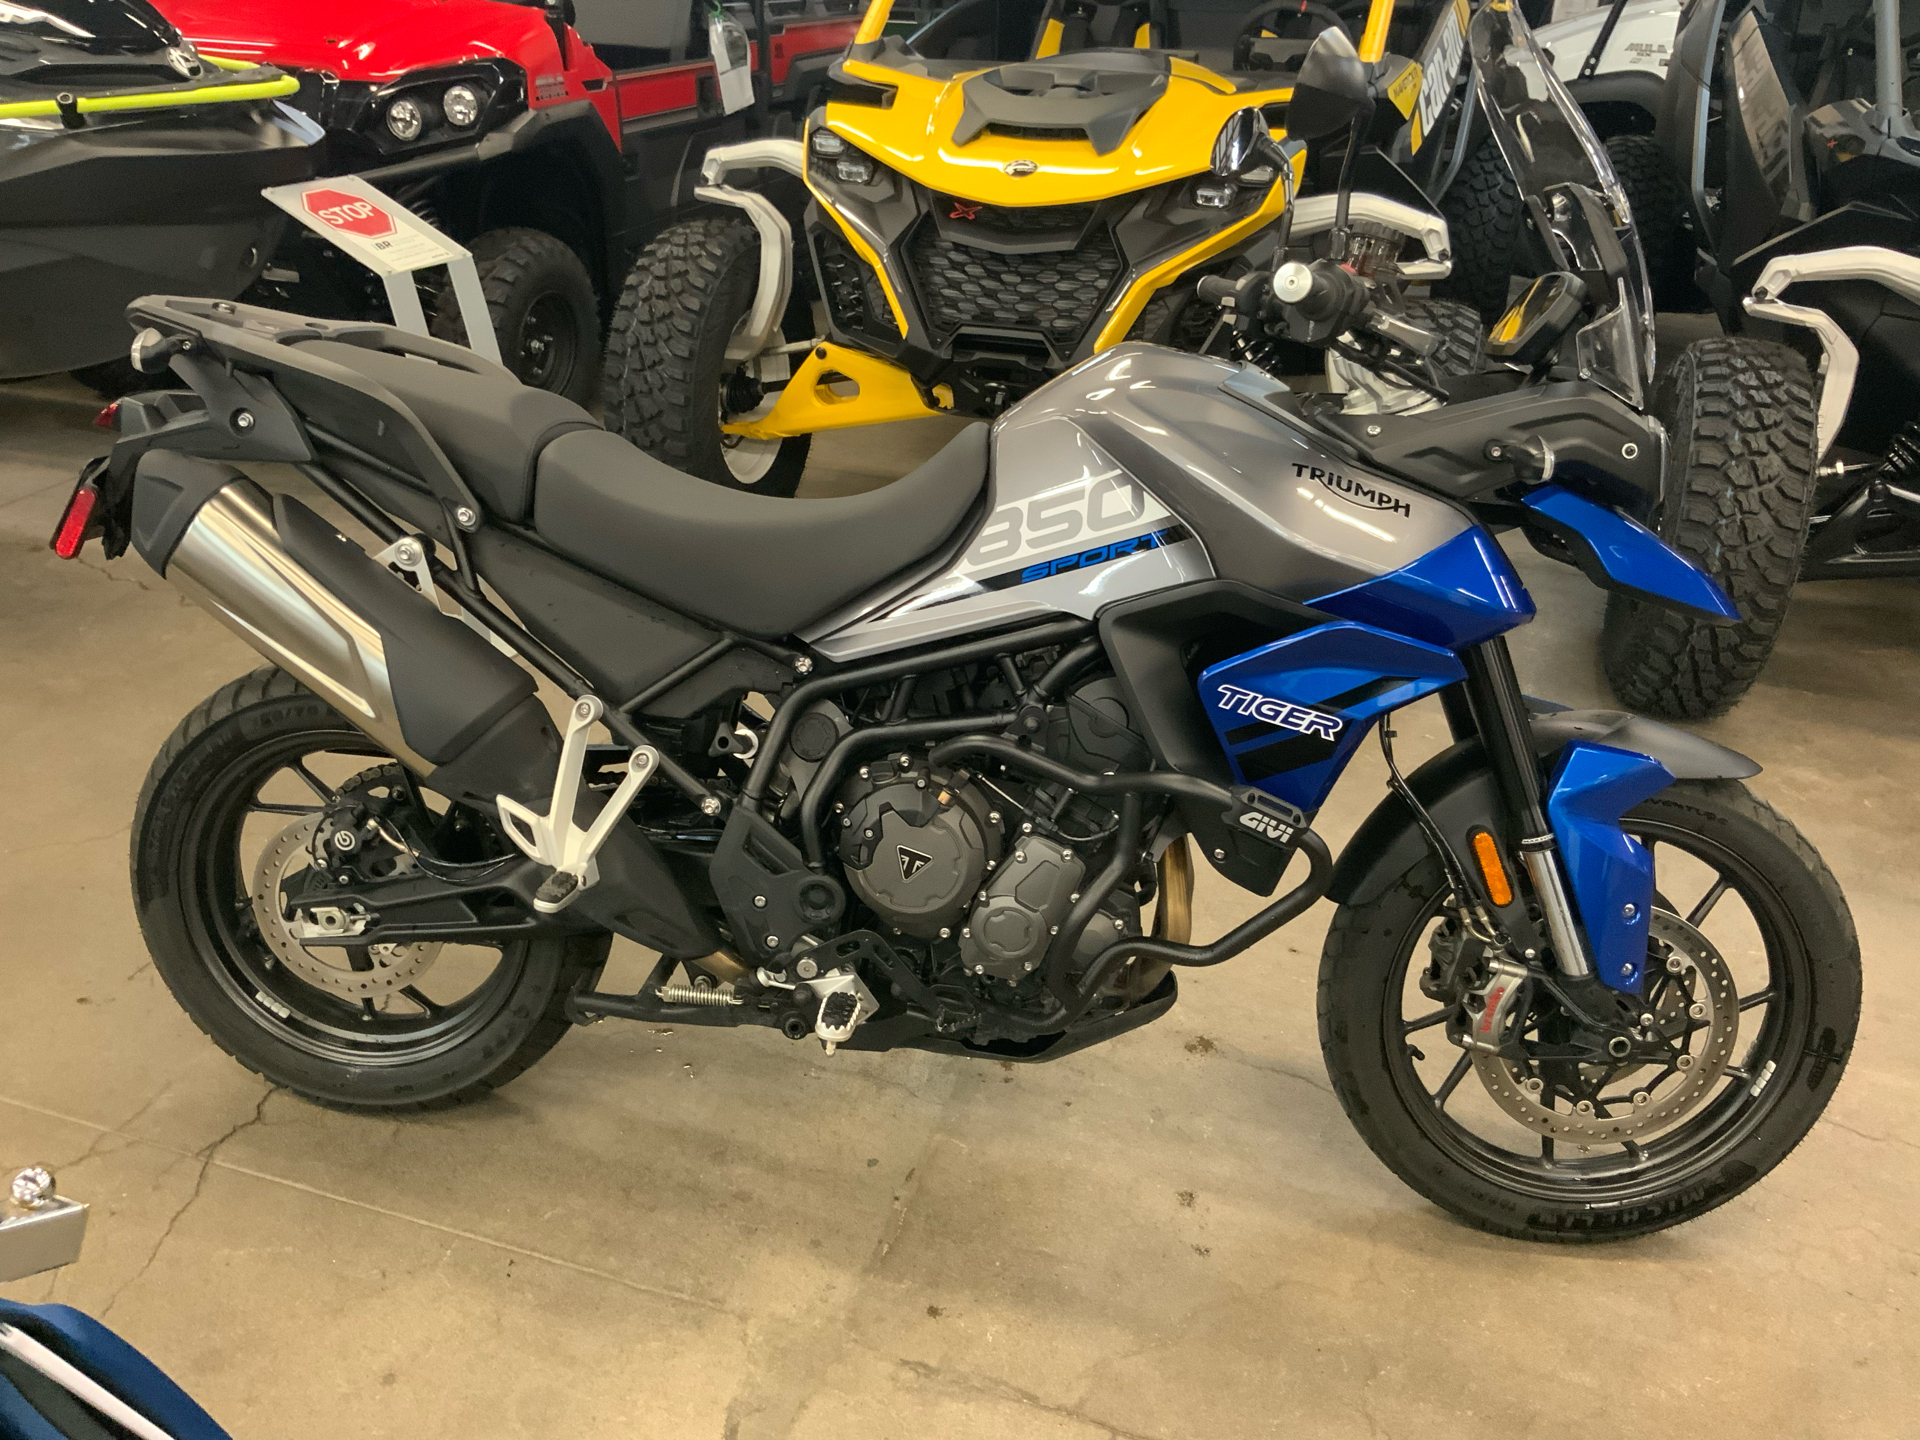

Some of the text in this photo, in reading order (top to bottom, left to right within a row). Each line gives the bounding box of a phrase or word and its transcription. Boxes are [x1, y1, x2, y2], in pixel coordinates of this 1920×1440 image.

[318, 201, 374, 225] STOP
[1292, 463, 1411, 518] TRIUMPH
[966, 477, 1146, 567] 850
[1021, 530, 1169, 583] SPORT
[1217, 684, 1343, 742] TIGER
[1239, 811, 1294, 843] GIVI
[1480, 986, 1505, 1033] brembo
